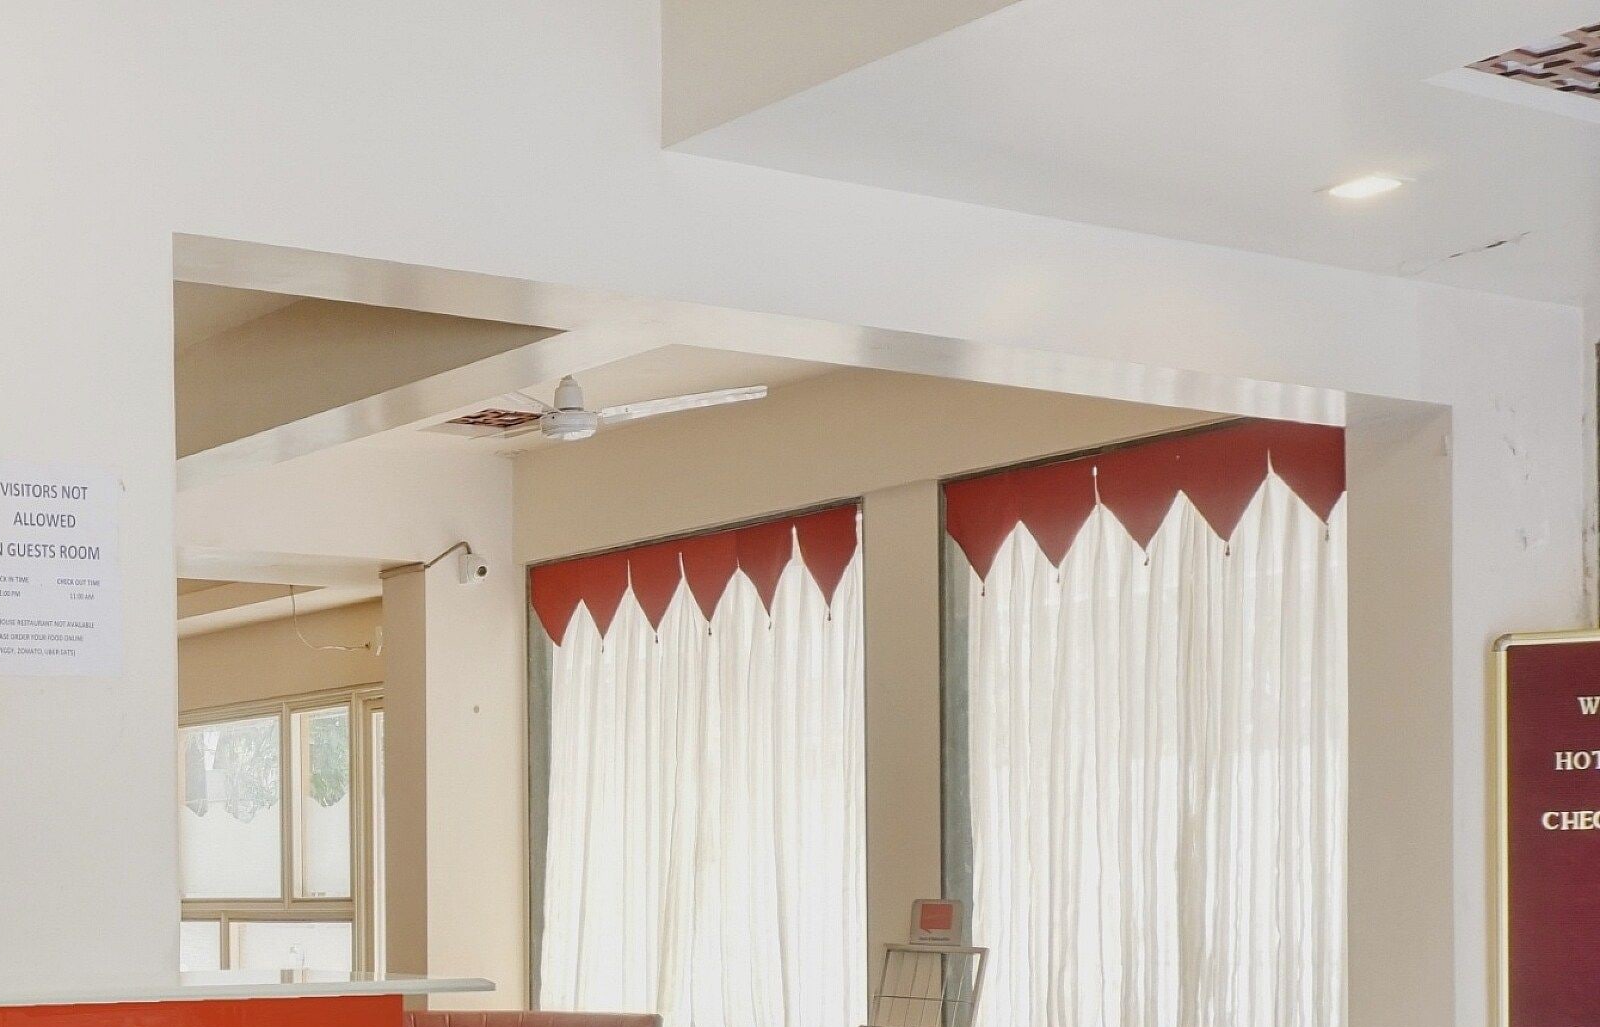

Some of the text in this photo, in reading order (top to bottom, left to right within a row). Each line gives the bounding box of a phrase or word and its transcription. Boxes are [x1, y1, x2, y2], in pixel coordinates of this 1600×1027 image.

[0, 482, 88, 500] VISITORS NOT
[13, 511, 76, 528] ALLOWED
[7, 543, 56, 559] GUESTS
[60, 545, 100, 560] ROOM
[16, 576, 30, 584] TIME
[56, 578, 74, 586] CHECK
[17, 620, 54, 628] RESTAURANT
[10, 633, 29, 641] ORDER
